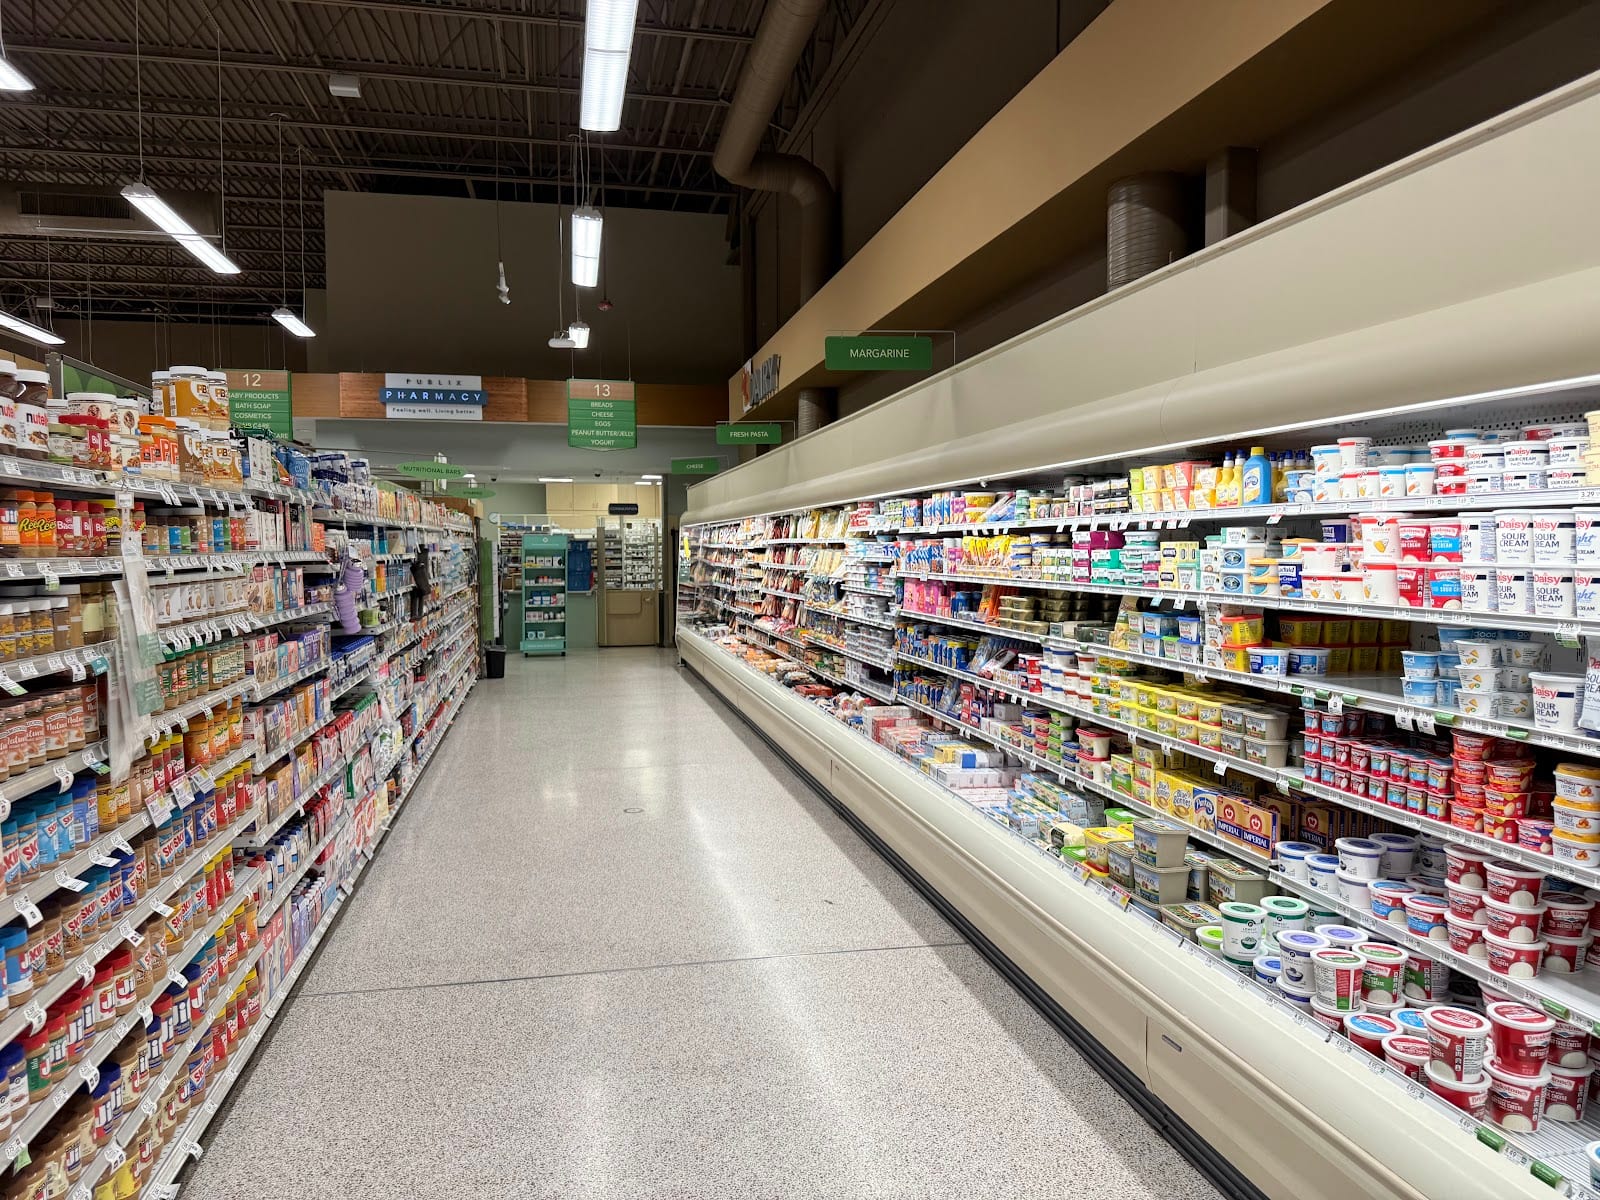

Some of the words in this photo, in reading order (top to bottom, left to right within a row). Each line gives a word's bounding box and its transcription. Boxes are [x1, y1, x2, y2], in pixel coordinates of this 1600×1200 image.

[849, 348, 910, 358] MARGARINE
[242, 373, 262, 387] 12
[406, 378, 462, 386] PUBLIX
[593, 383, 611, 397] 13
[385, 390, 481, 401] PHARMACY
[1511, 447, 1531, 456] Daisy
[403, 466, 444, 474] NUTRITIONAL
[1552, 470, 1573, 479] Daisy
[1499, 518, 1530, 531] Daisy
[1501, 532, 1526, 540] SOUR
[1499, 539, 1529, 547] CREAM
[1533, 573, 1561, 586] Daisy
[1535, 701, 1556, 711] SOUR
[1217, 820, 1240, 837] IMPERIAL
[1243, 832, 1268, 848] IMPERIAL
